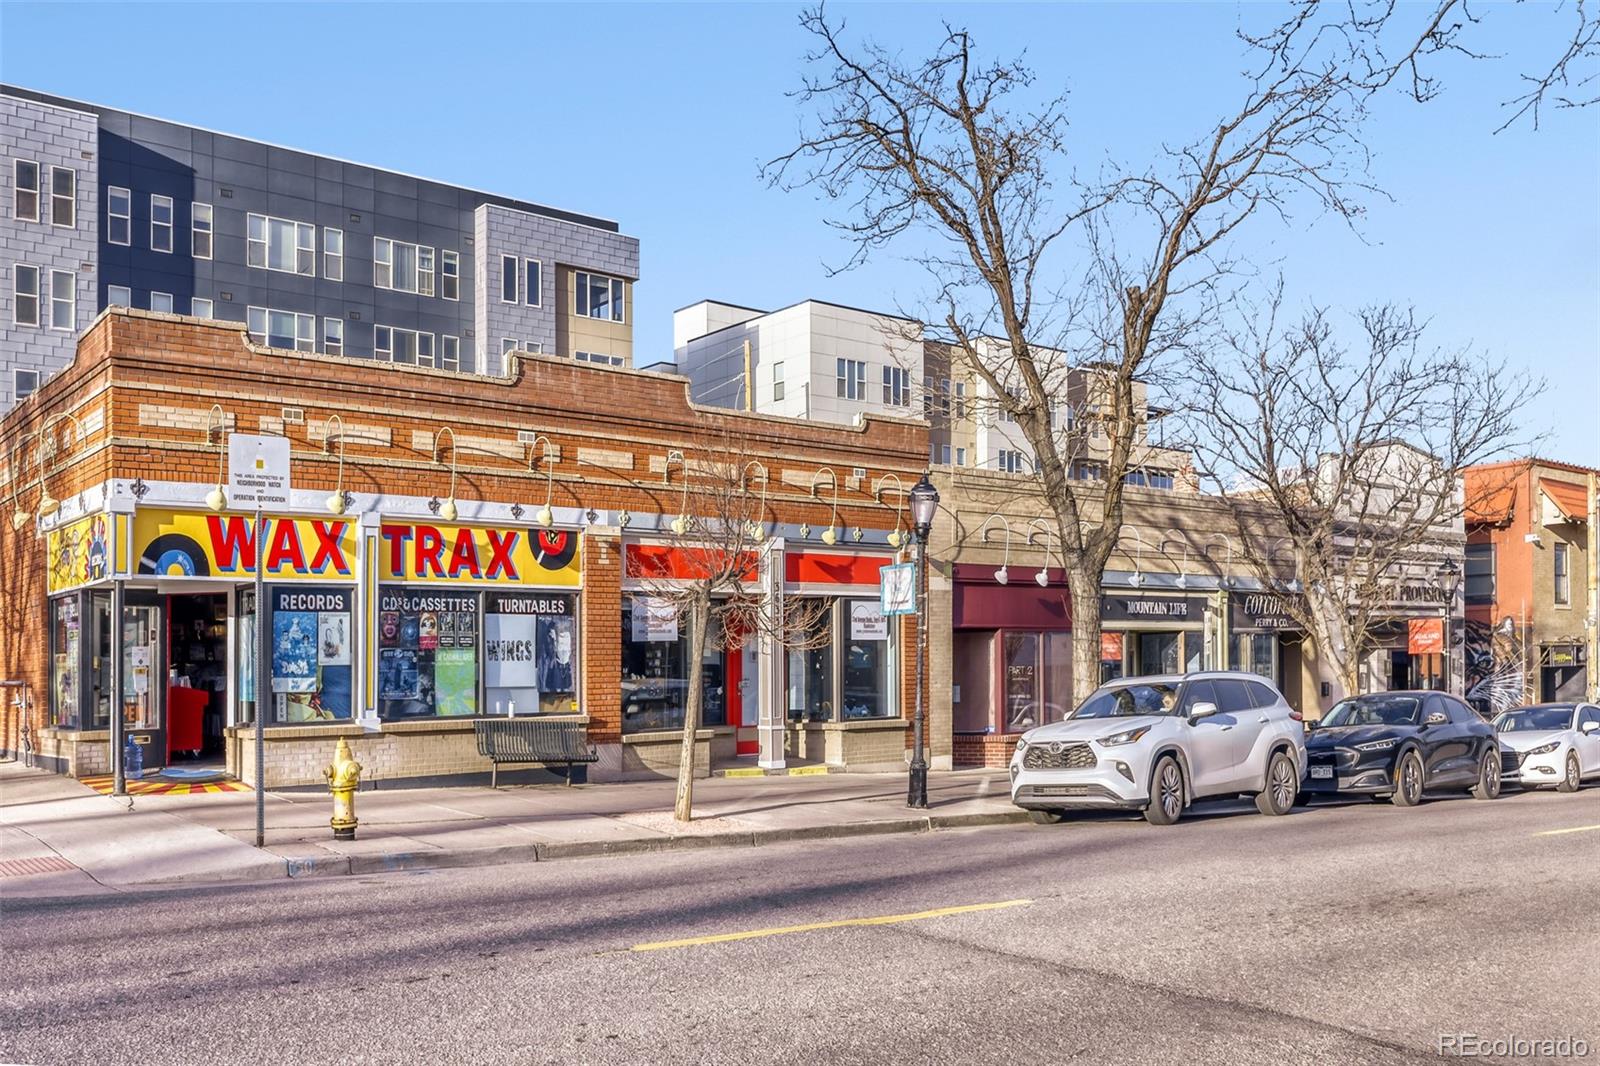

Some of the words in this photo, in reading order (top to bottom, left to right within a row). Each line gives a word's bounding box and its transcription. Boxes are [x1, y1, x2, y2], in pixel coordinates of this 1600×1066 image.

[206, 515, 351, 575] WAX
[381, 524, 520, 580] TRAX
[280, 594, 344, 610] RECORDS
[411, 597, 476, 612] CASSETTES
[498, 599, 565, 613] TURNTABLES
[1127, 601, 1167, 615] MOUNTAIN
[1169, 602, 1187, 615] LIFE
[1008, 665, 1026, 675] PART
[1027, 665, 1033, 675] 2
